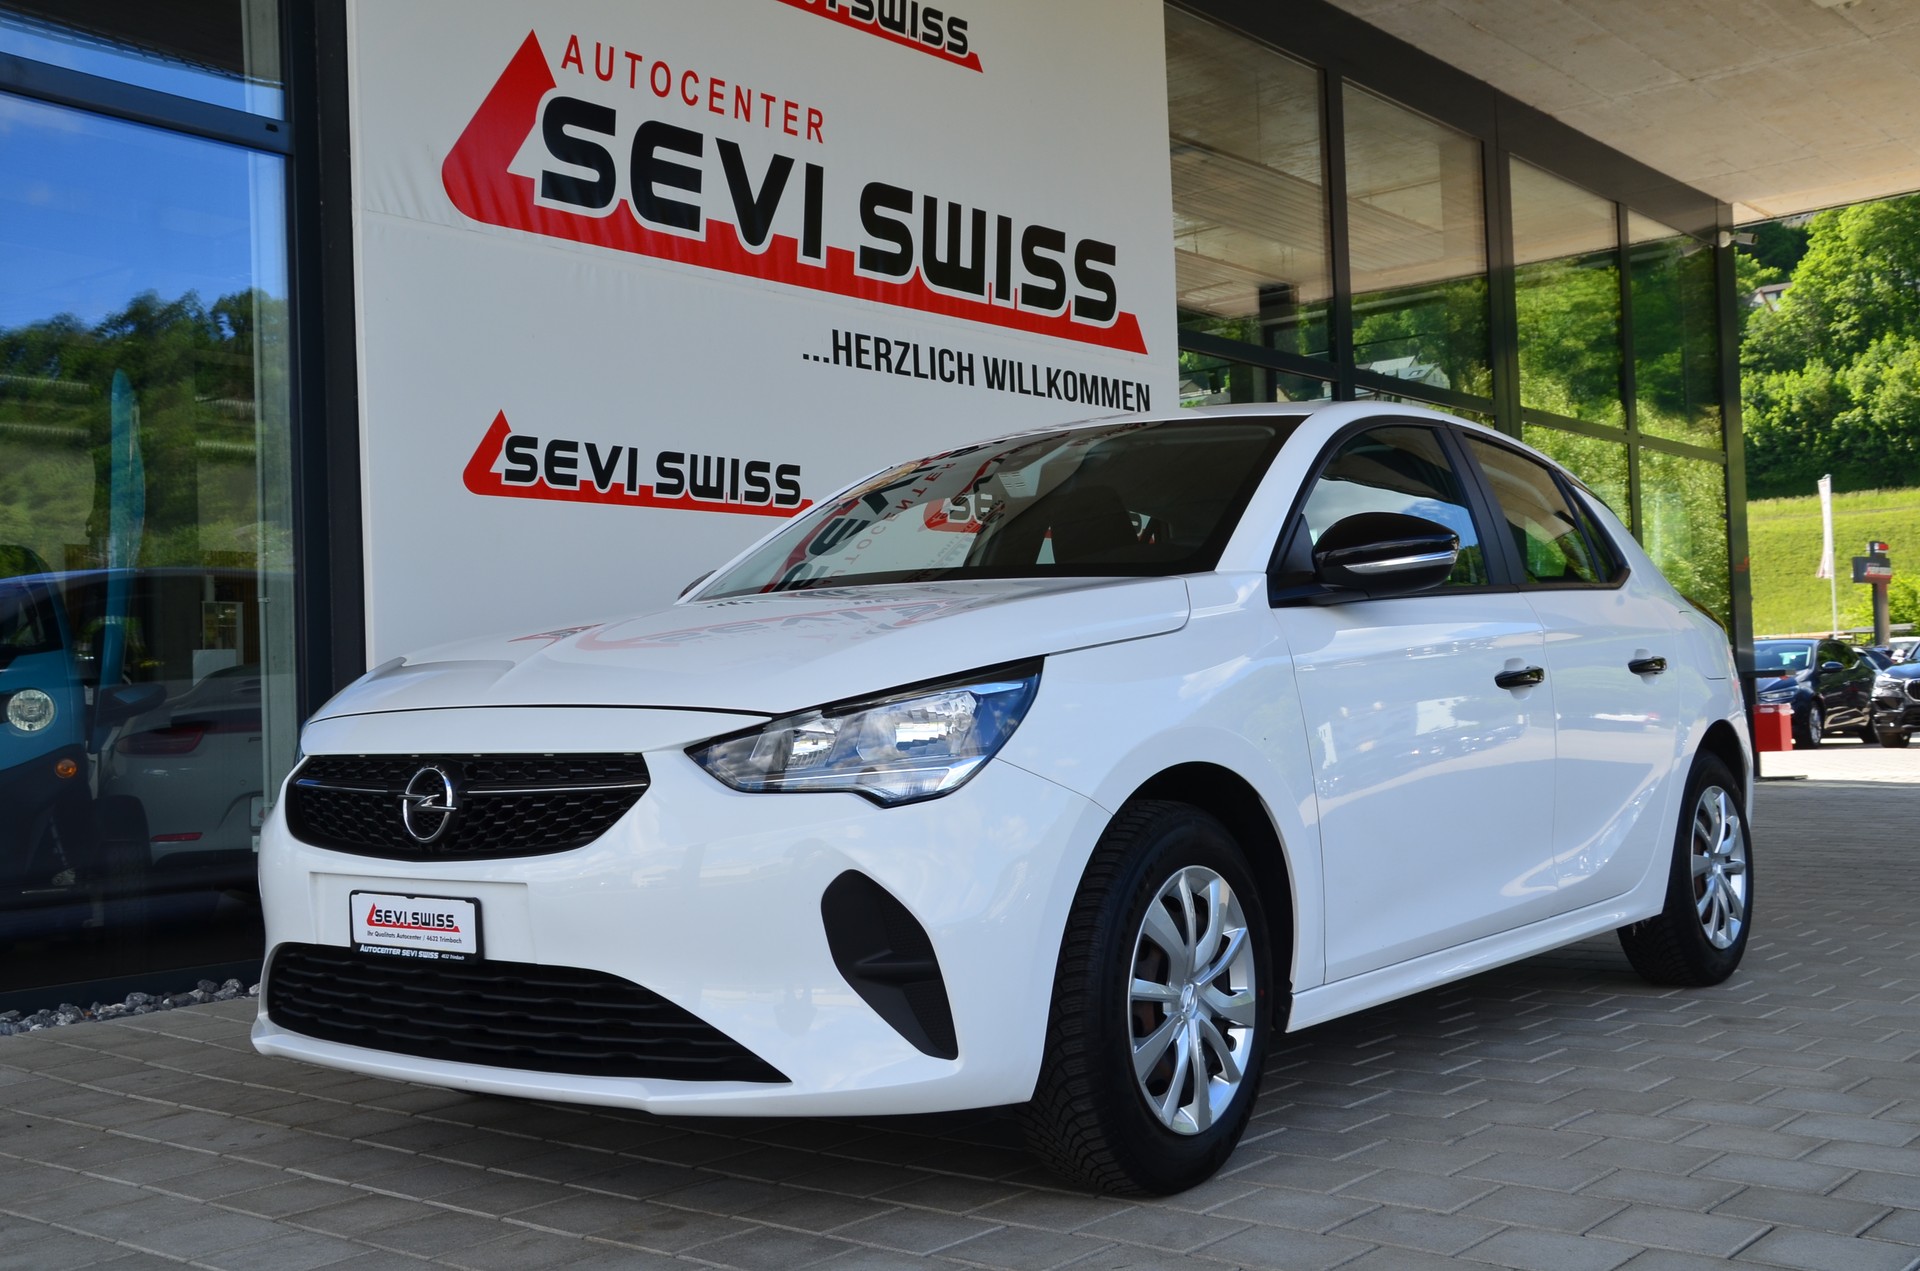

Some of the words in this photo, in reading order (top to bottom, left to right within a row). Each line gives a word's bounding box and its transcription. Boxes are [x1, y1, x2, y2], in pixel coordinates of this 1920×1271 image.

[561, 34, 823, 144] AUTOCENTER
[541, 96, 824, 260] SEVI
[859, 181, 1117, 322] SWISS
[982, 355, 1151, 413] WILLKOMMEN
[504, 435, 639, 492] SEVI
[655, 451, 801, 506] SWISS
[375, 909, 407, 925] SEVI
[411, 911, 455, 929] SWISS
[396, 932, 422, 941] Autocenter
[439, 936, 463, 944] Trimbach
[401, 949, 418, 958] SEVI
[418, 950, 439, 960] SWISS
